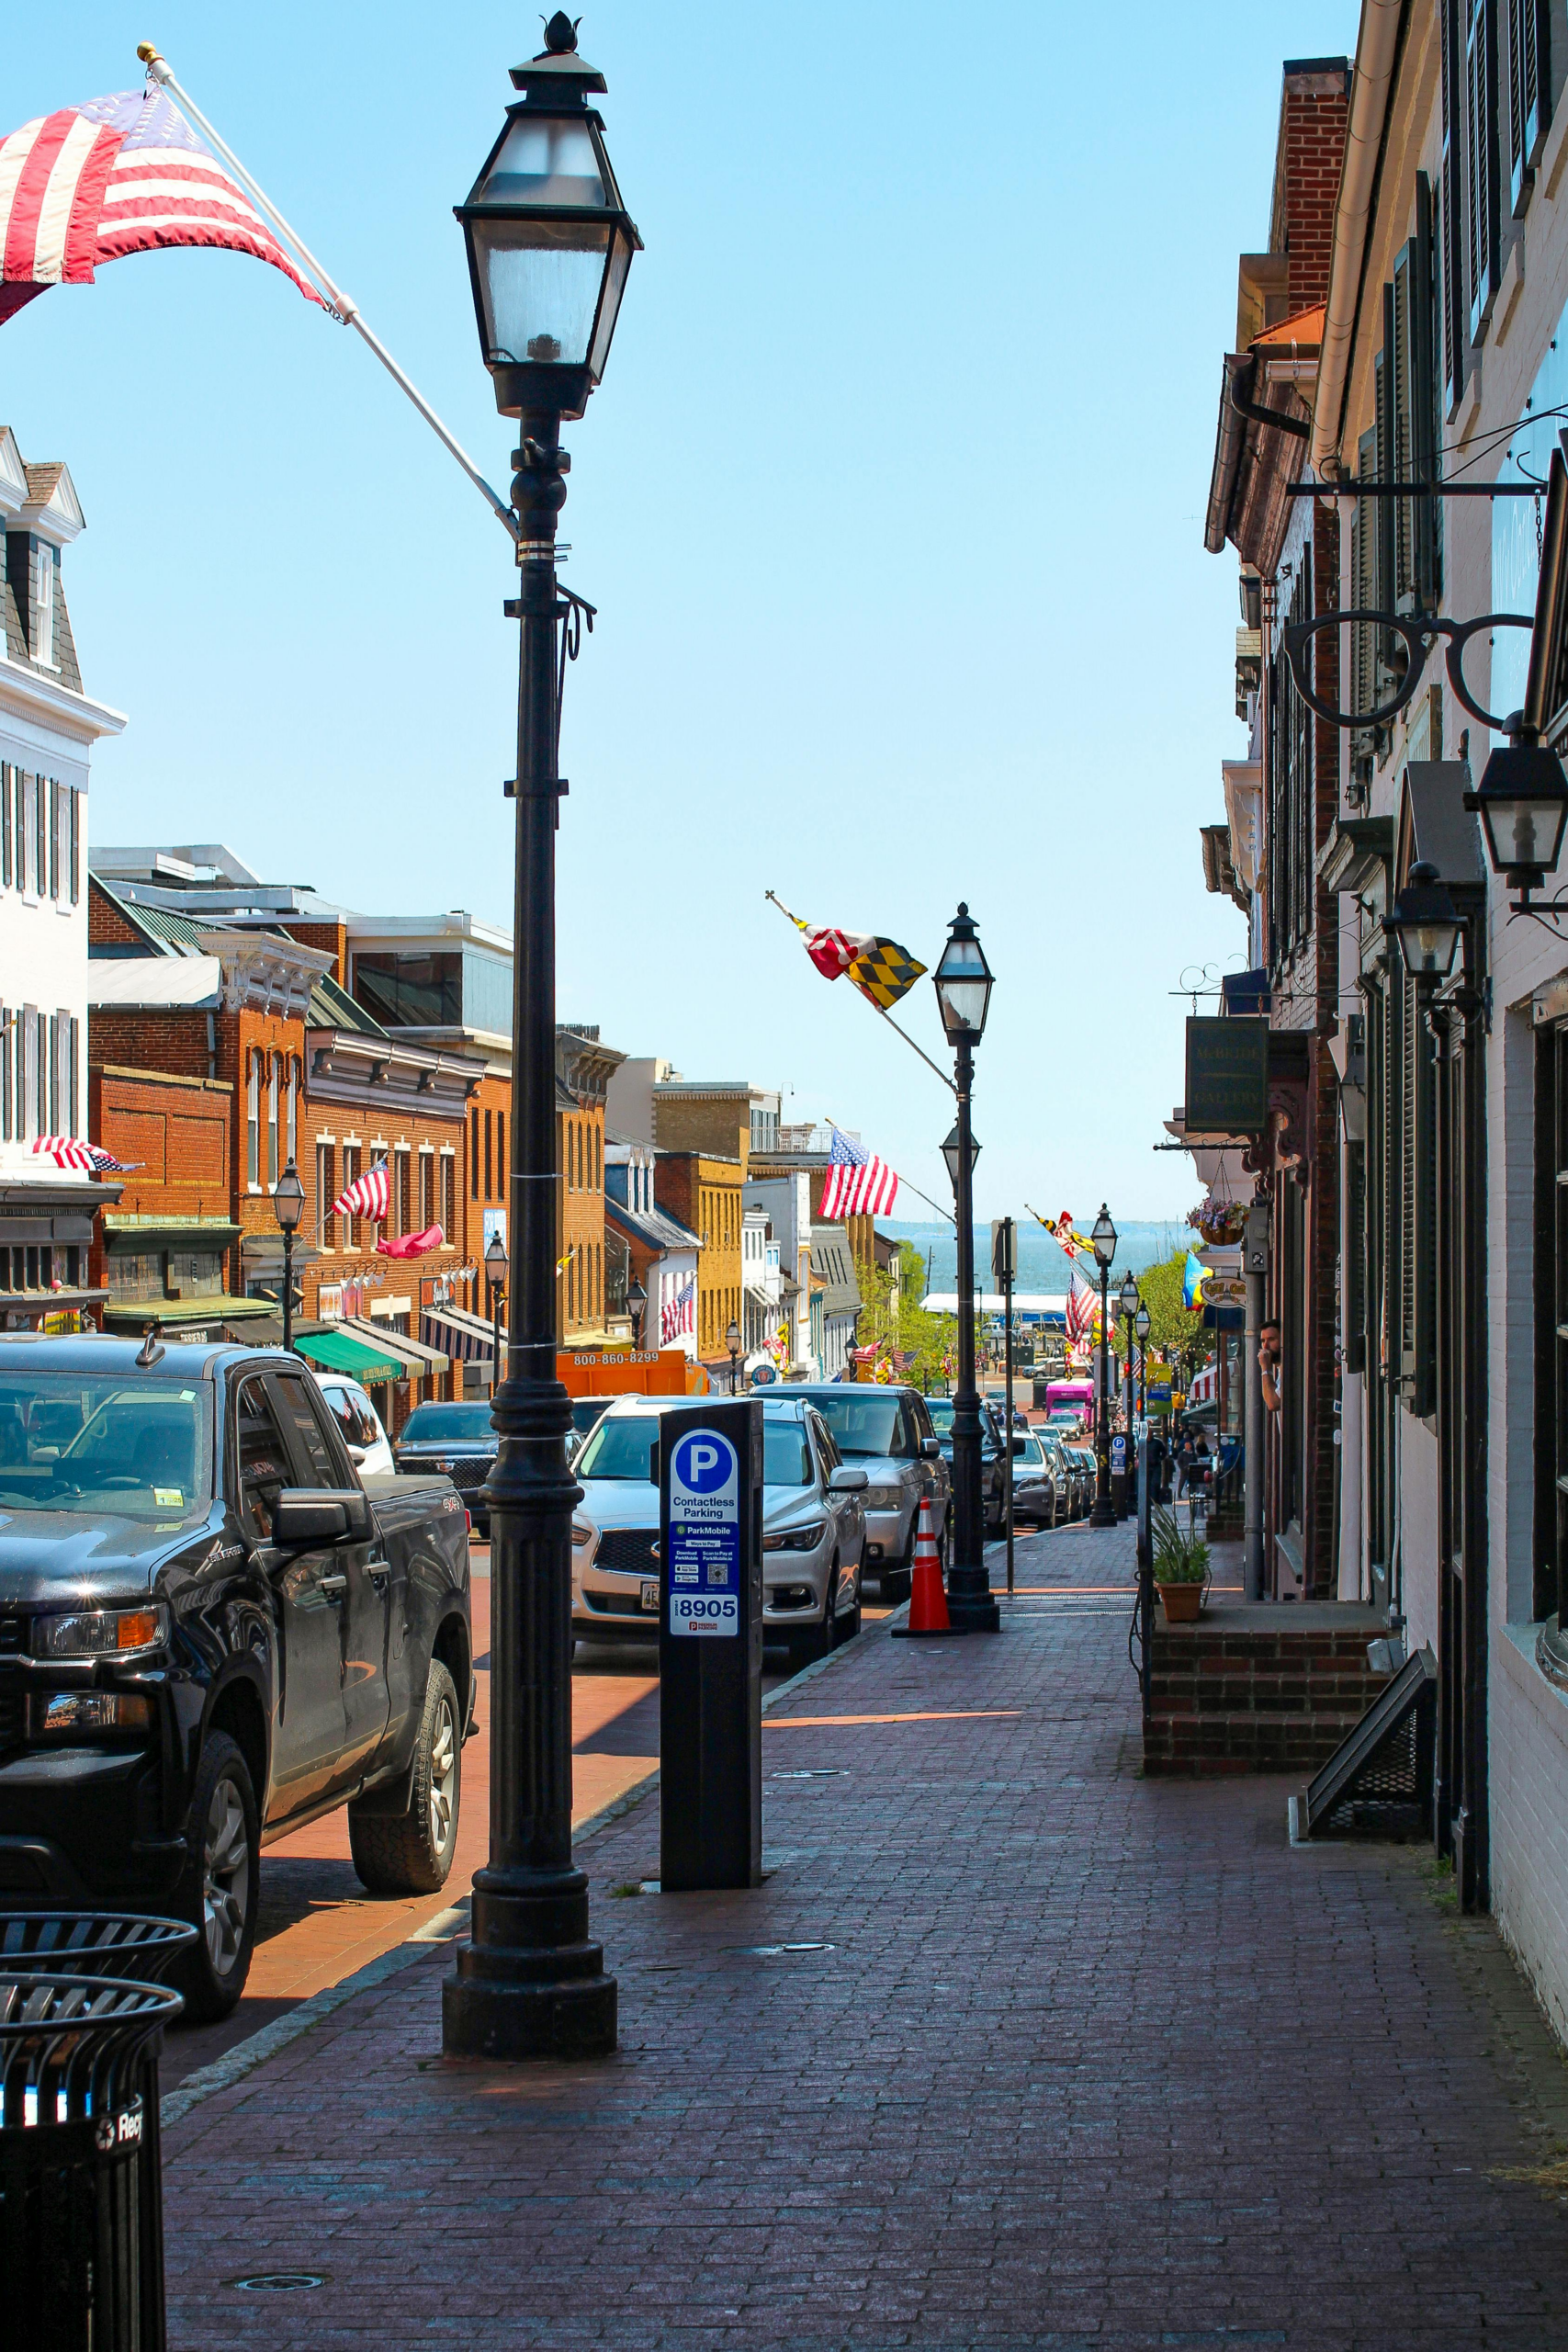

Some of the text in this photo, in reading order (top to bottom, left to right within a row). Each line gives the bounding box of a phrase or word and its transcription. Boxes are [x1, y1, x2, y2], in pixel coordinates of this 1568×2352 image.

[1195, 1091, 1258, 1103] GALLERY
[574, 1352, 659, 1365] 800-860-8299
[691, 1445, 718, 1482] P
[673, 1497, 735, 1507] Contactless
[683, 1508, 723, 1519] Parking
[680, 1600, 736, 1617] 8905
